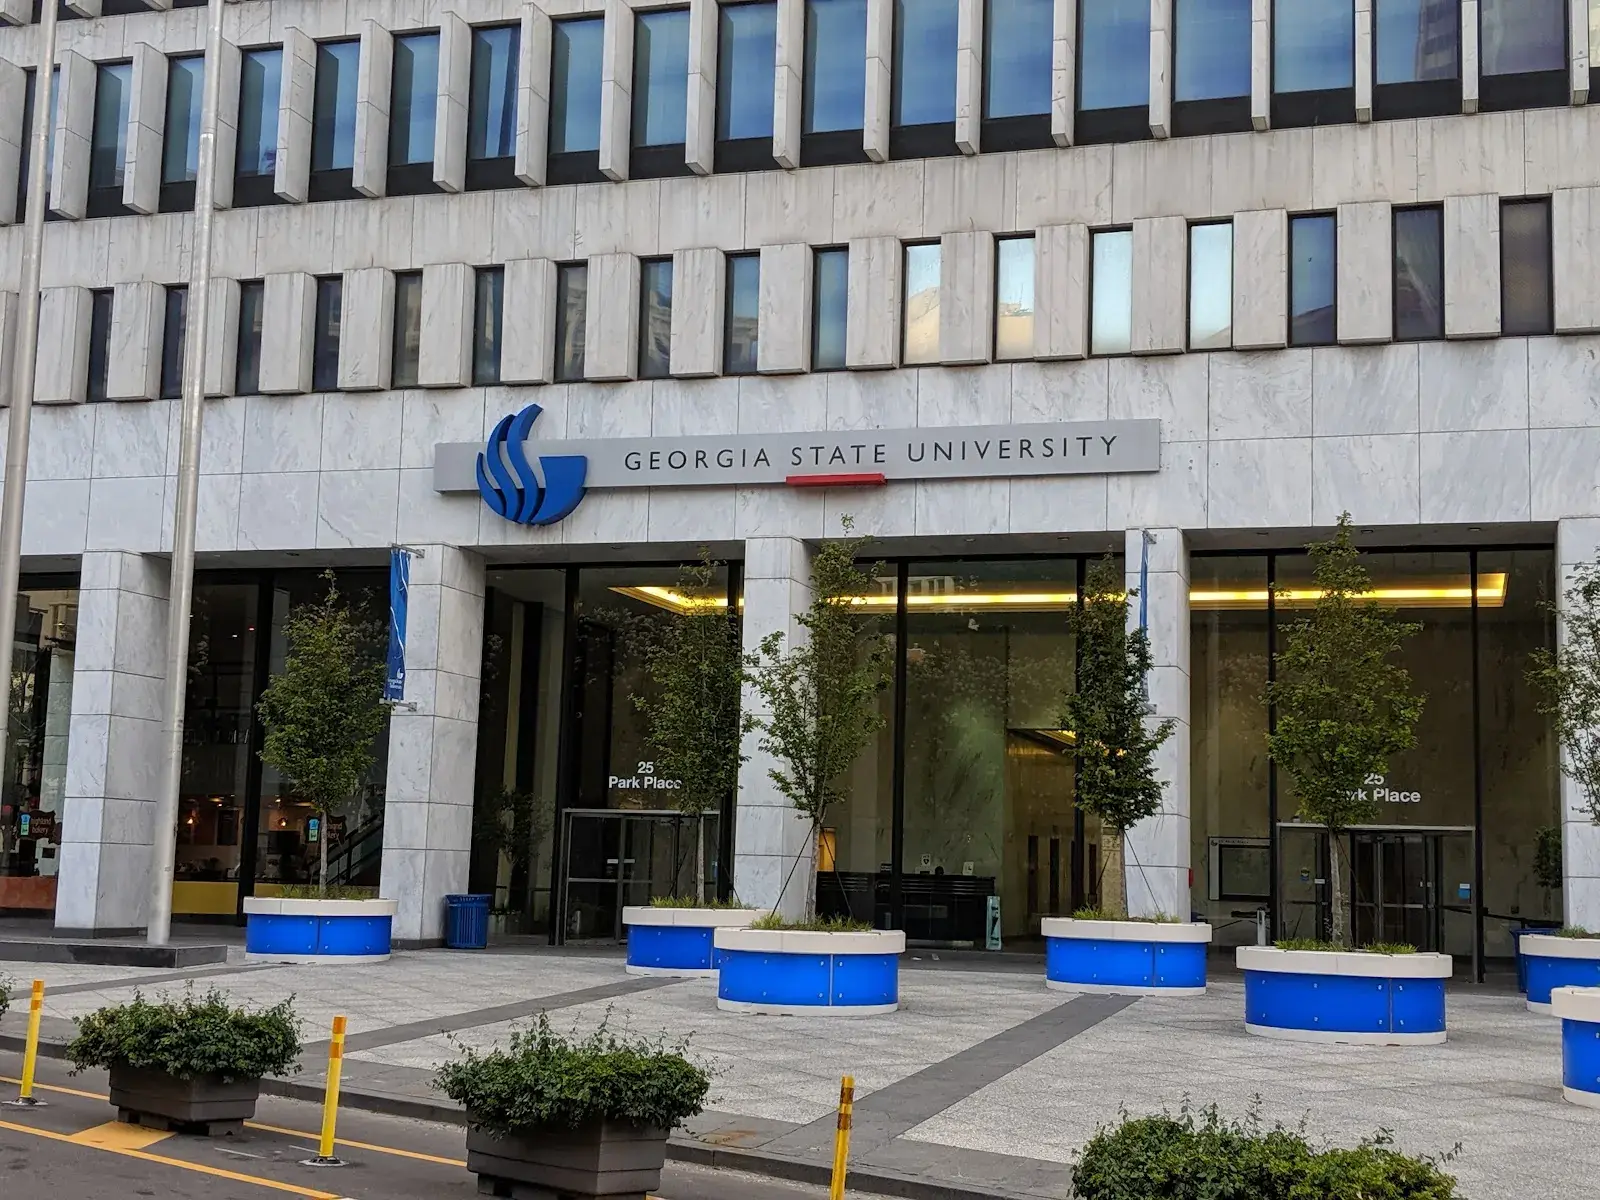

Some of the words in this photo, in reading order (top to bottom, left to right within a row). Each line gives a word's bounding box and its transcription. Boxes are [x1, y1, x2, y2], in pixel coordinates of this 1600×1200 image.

[624, 447, 772, 471] GEORGIA
[791, 444, 887, 466] STATE
[907, 435, 1119, 463] UNIVERSITY
[638, 761, 654, 774] 25
[608, 775, 641, 789] Park
[643, 776, 683, 789] Place
[1363, 772, 1385, 786] 25
[1373, 788, 1422, 803] Place
